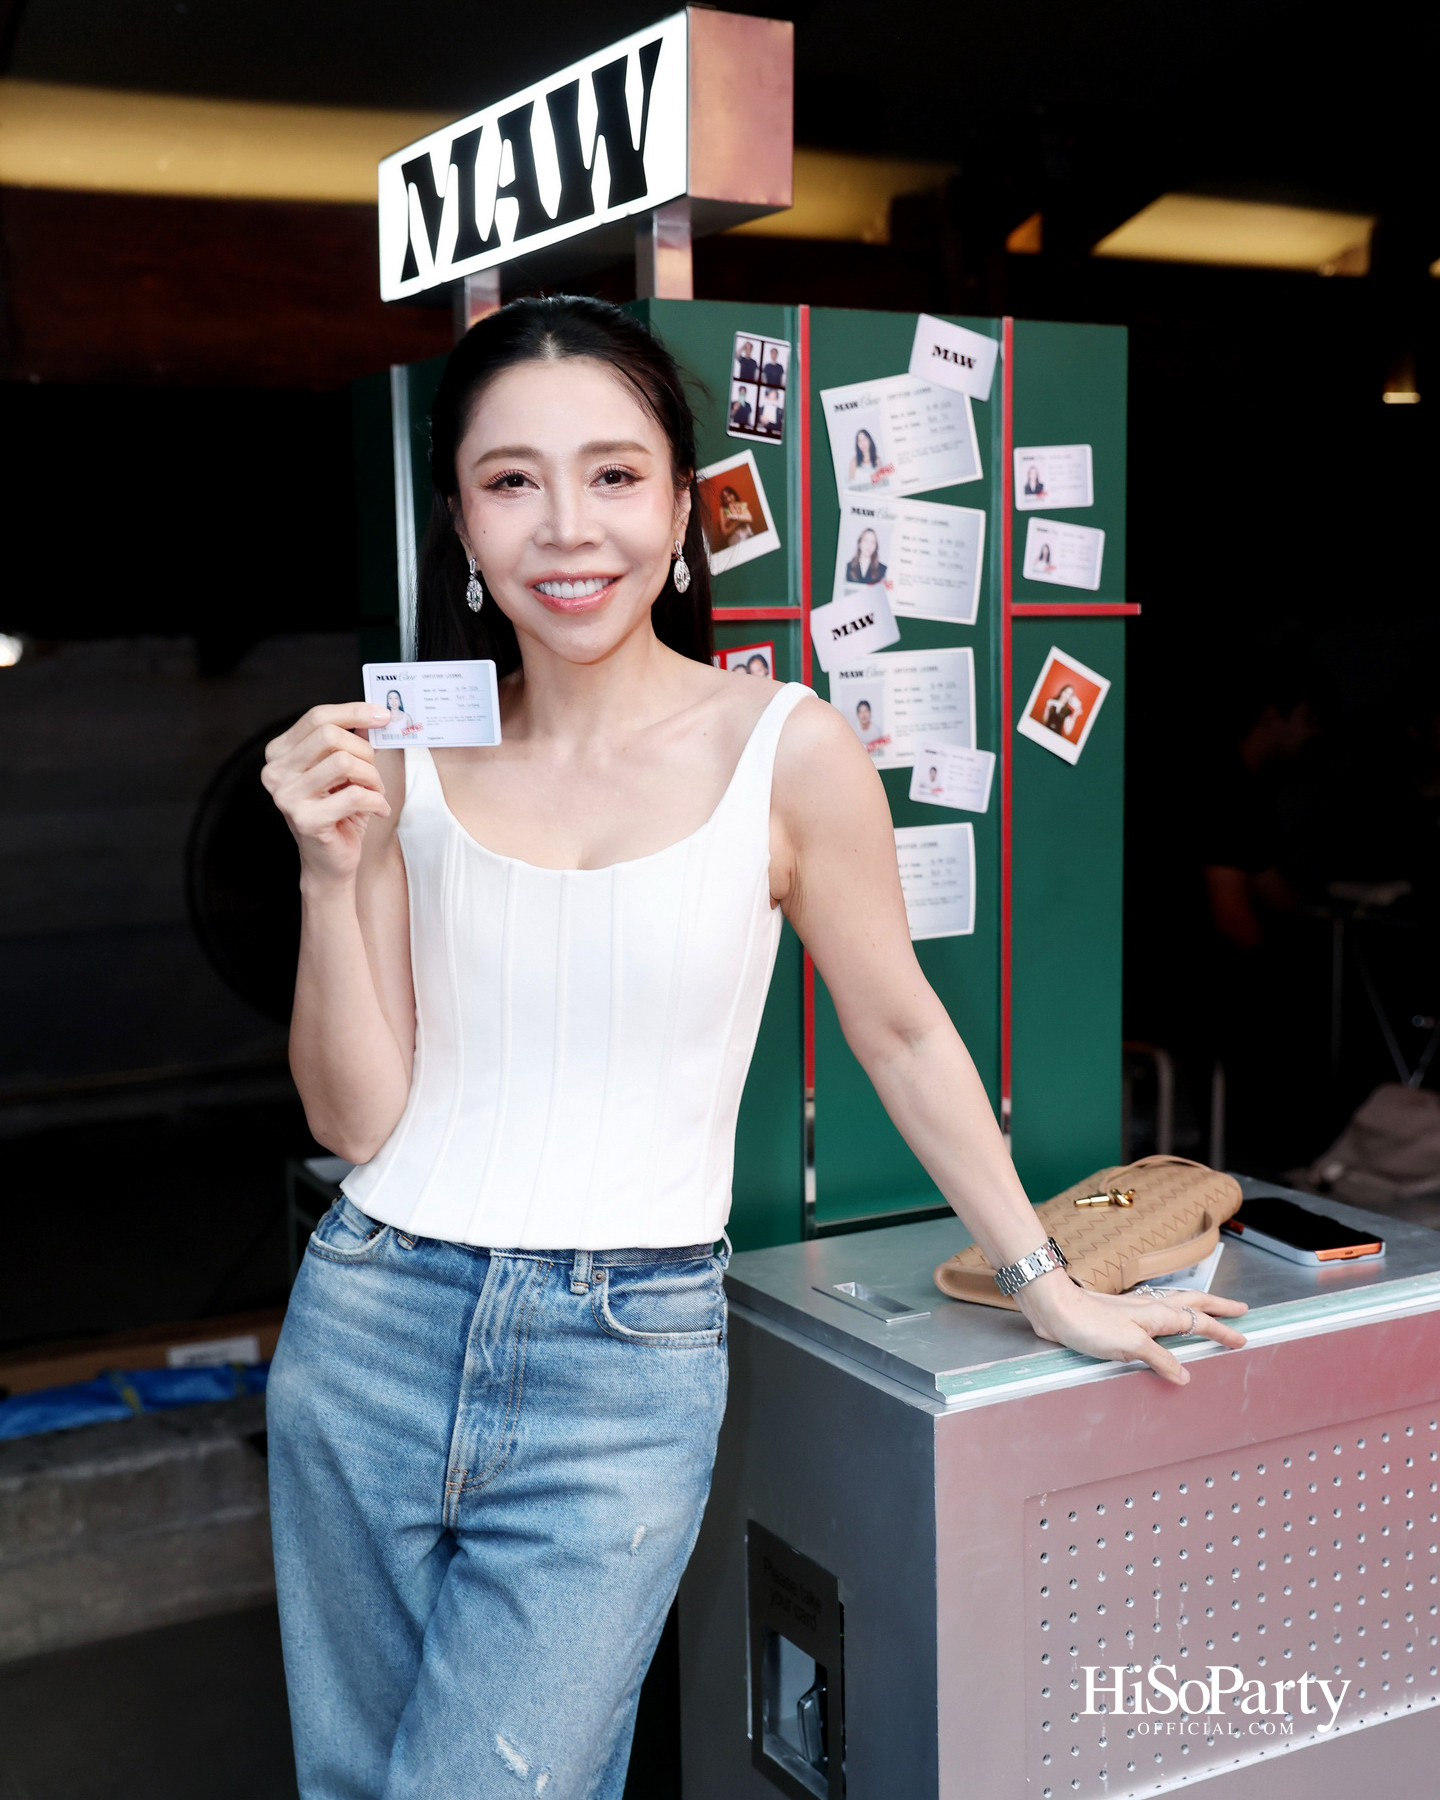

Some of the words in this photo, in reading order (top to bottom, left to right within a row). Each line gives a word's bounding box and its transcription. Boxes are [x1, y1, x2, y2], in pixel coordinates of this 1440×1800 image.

[400, 37, 663, 283] MAW
[932, 345, 976, 369] MAW
[834, 400, 859, 412] MAW
[851, 507, 875, 517] MAW
[831, 613, 874, 640] MAW
[839, 669, 864, 679] MAW
